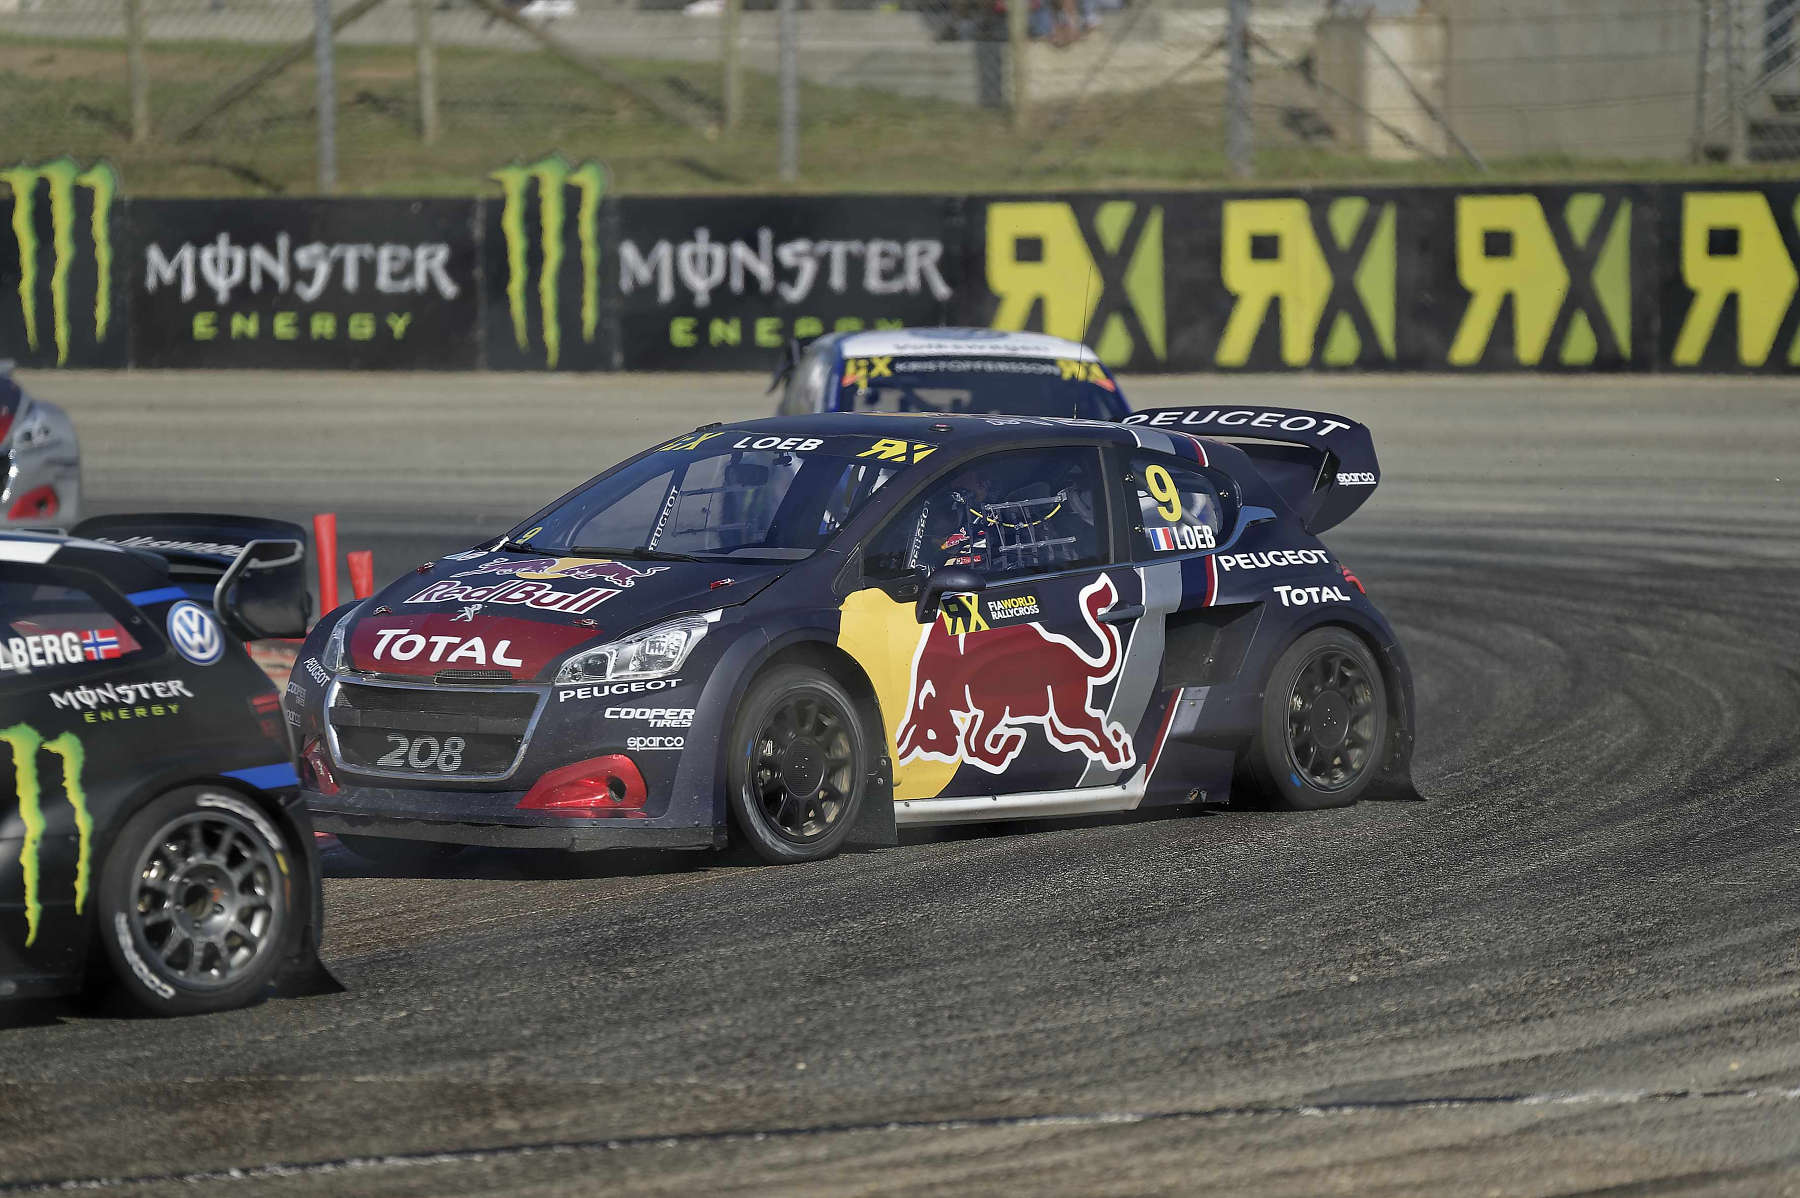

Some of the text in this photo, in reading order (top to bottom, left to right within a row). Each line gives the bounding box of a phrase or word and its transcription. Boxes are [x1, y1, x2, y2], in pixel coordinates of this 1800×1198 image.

[144, 232, 460, 303] MONSTER
[618, 227, 953, 307] MONSTER
[1447, 194, 1632, 366] RX
[1672, 191, 1800, 367] R
[1213, 197, 1396, 367] RX
[192, 311, 412, 341] ENERGY
[1121, 410, 1351, 437] PEUGEOT
[733, 436, 824, 451] LOEB
[1145, 464, 1183, 522] 9
[1337, 472, 1376, 487] sparco
[650, 486, 678, 551] EUGEOT
[1173, 525, 1216, 550] LOEB
[1218, 549, 1330, 572] PEUGEOT
[1273, 585, 1351, 607] TOTAL
[990, 604, 1040, 620] RALLYCROSS
[373, 628, 522, 668] TOTAL
[303, 657, 331, 687] PEUGEOT
[49, 680, 195, 711] MONSTER
[559, 678, 683, 703] PEUGEOT
[83, 703, 180, 723] ENERGY
[604, 708, 695, 722] COOPER
[648, 718, 694, 728] TIRES
[376, 734, 466, 772] 208
[627, 736, 684, 750] sparco
